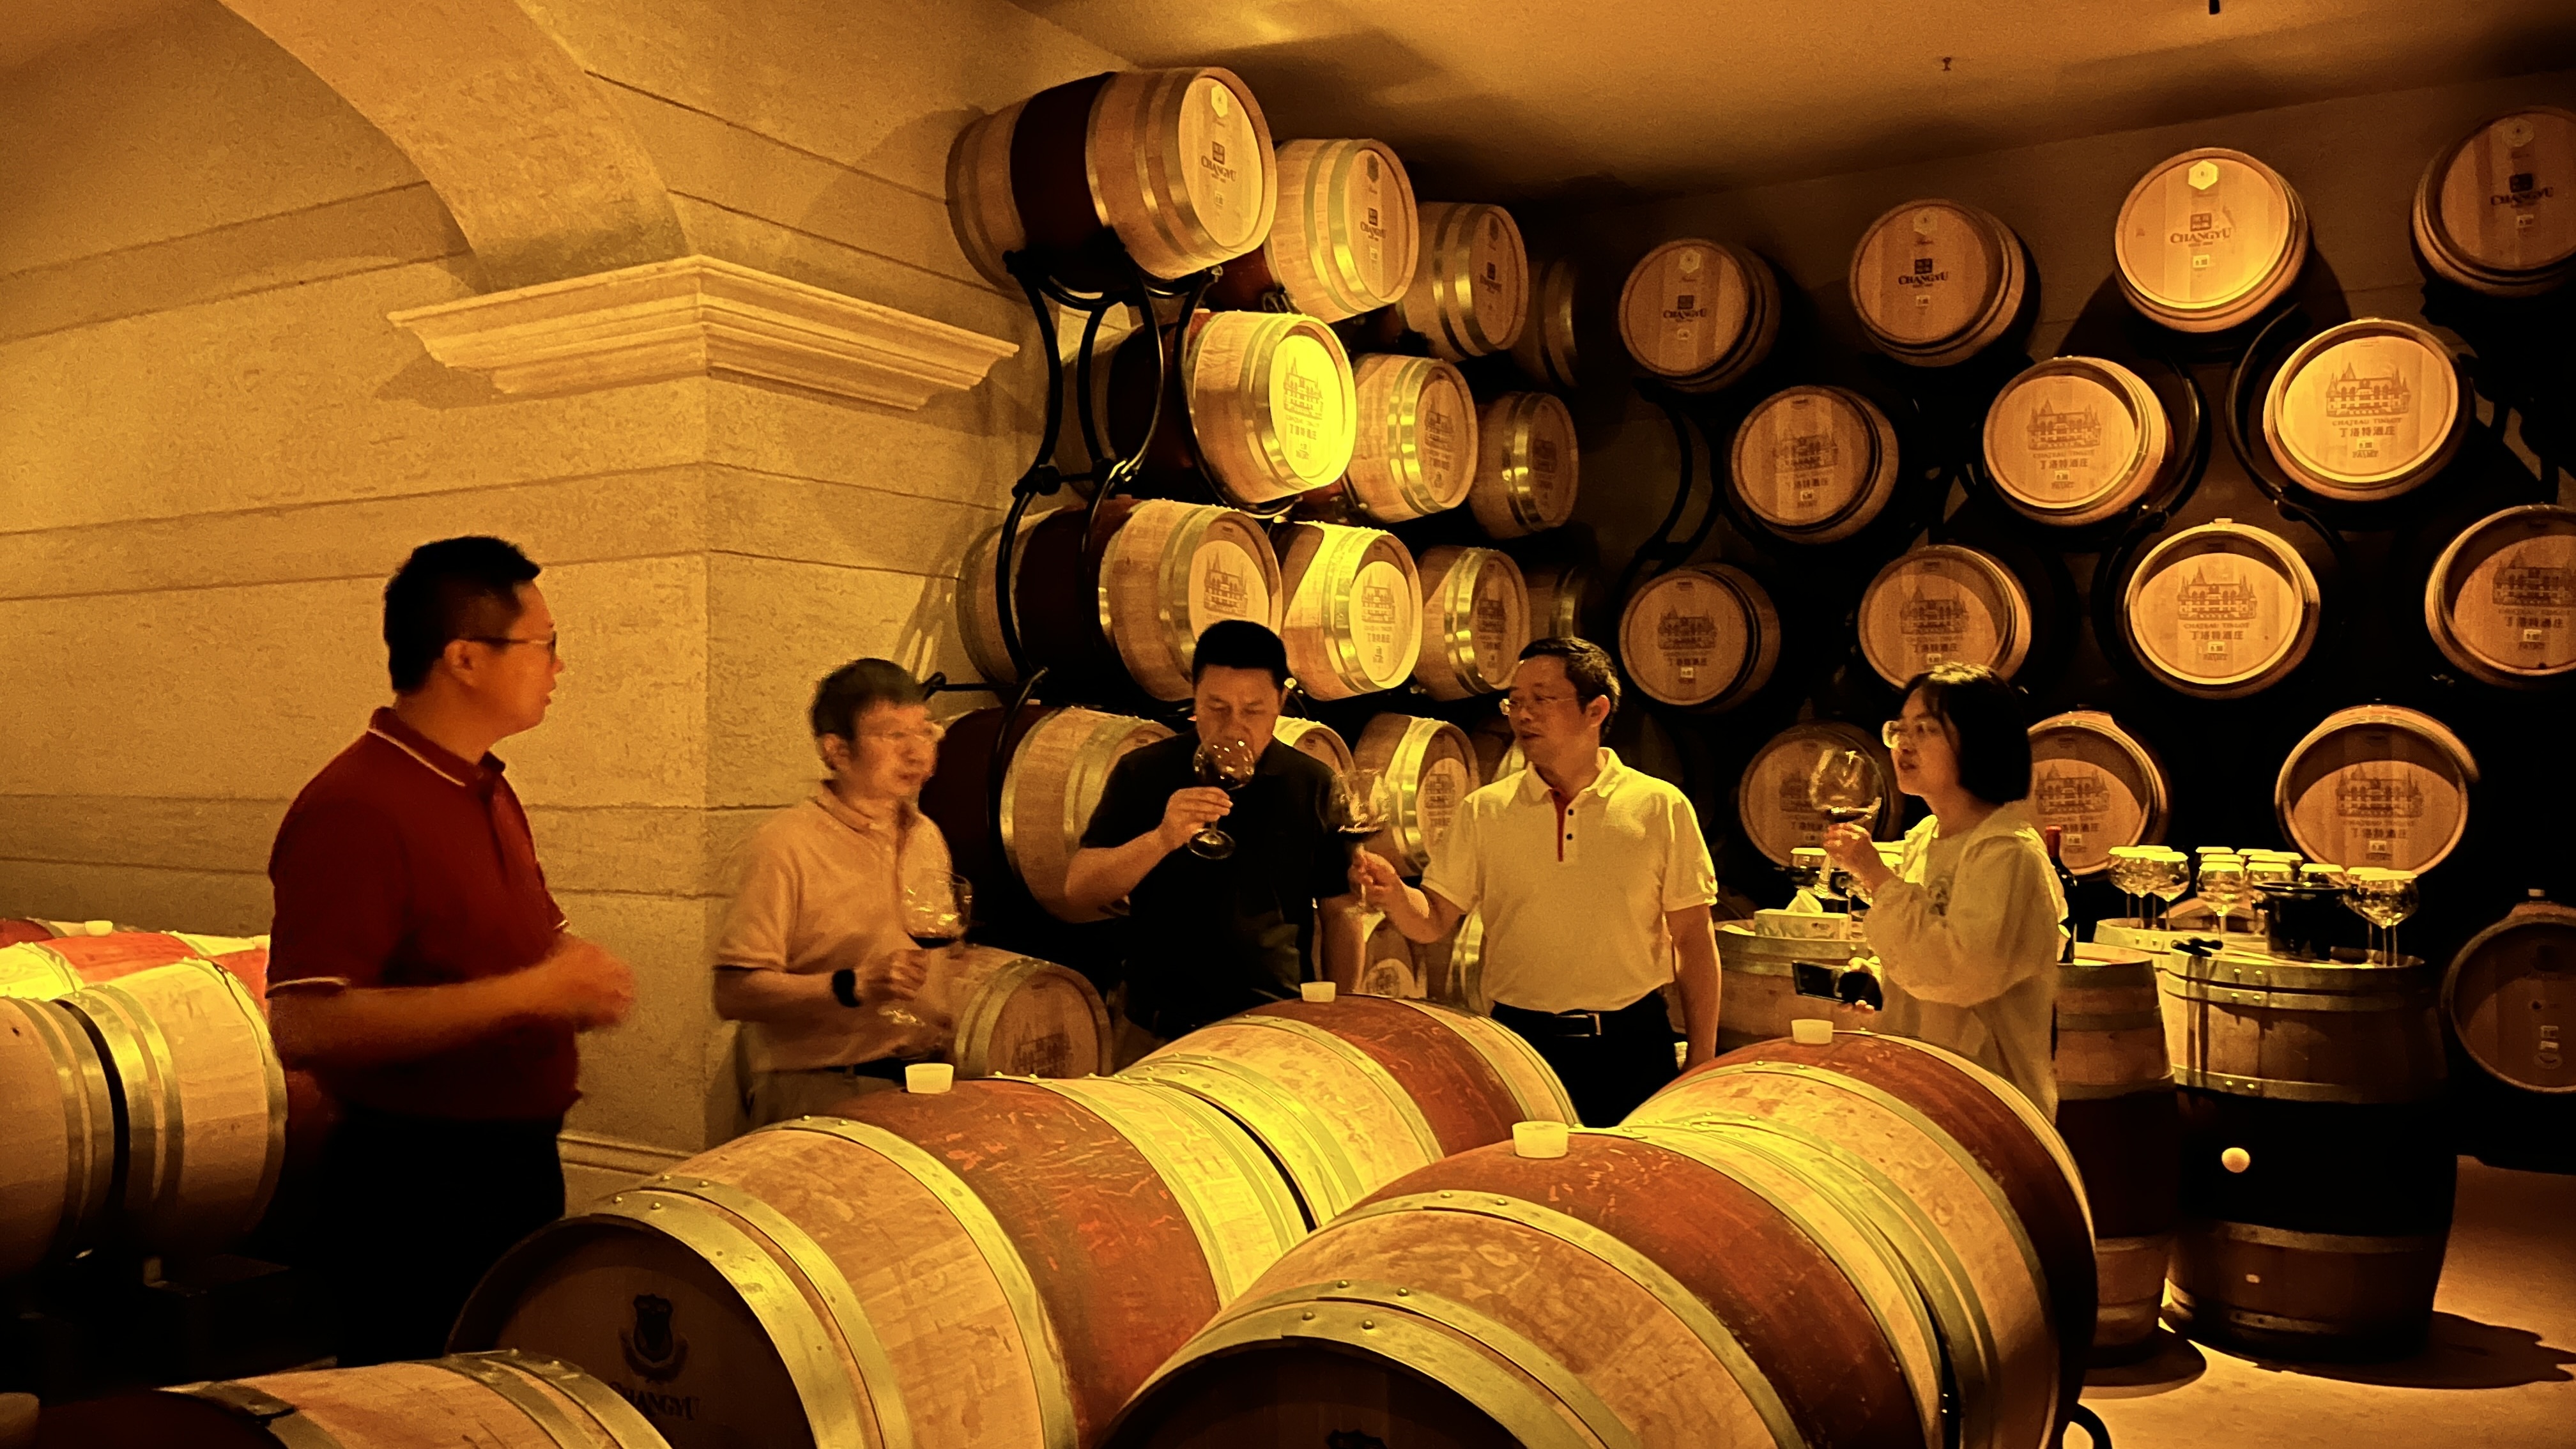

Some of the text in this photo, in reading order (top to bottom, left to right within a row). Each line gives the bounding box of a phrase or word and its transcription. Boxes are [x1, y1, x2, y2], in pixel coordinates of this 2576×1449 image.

[1200, 155, 1237, 182] CHANGYU
[2170, 227, 2232, 244] CHANGYU
[1898, 272, 1949, 285] CHANGYU
